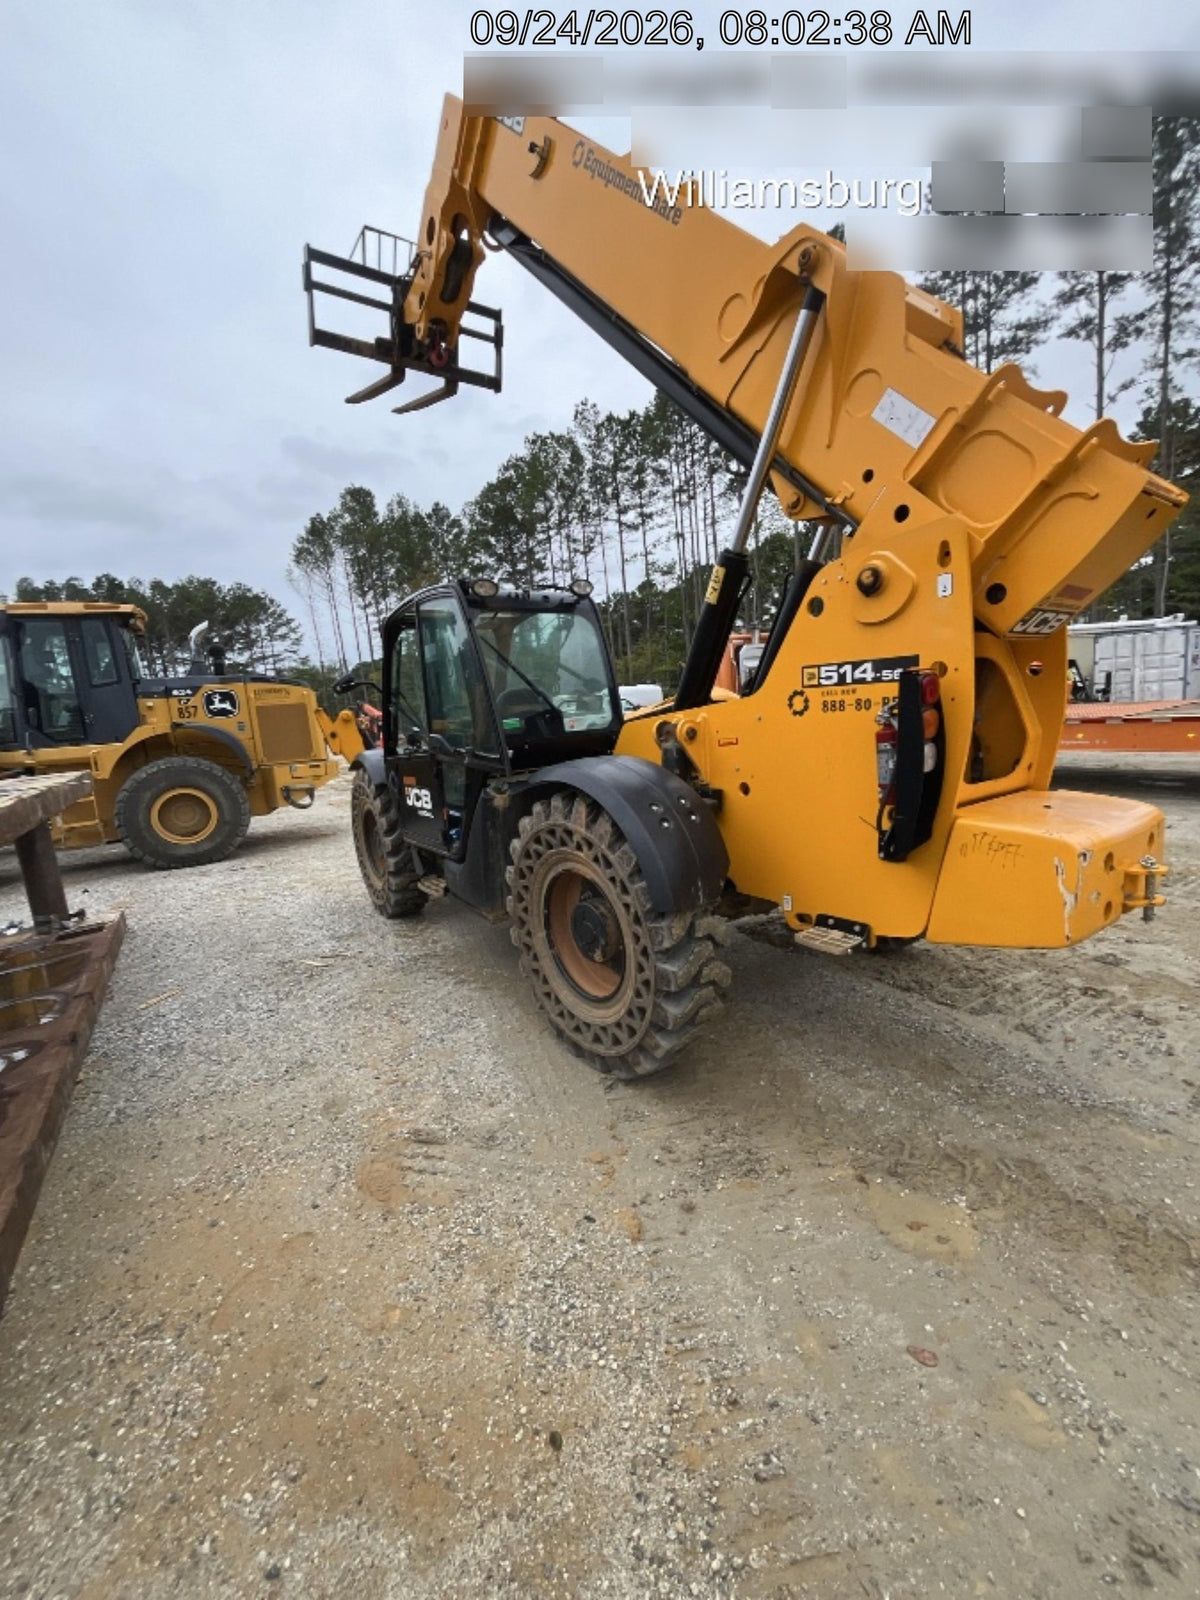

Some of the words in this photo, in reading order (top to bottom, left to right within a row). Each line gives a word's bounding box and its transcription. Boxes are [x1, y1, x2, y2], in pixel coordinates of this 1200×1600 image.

[1012, 610, 1071, 634] JCB
[177, 705, 198, 719] 857
[406, 786, 433, 810] JCB
